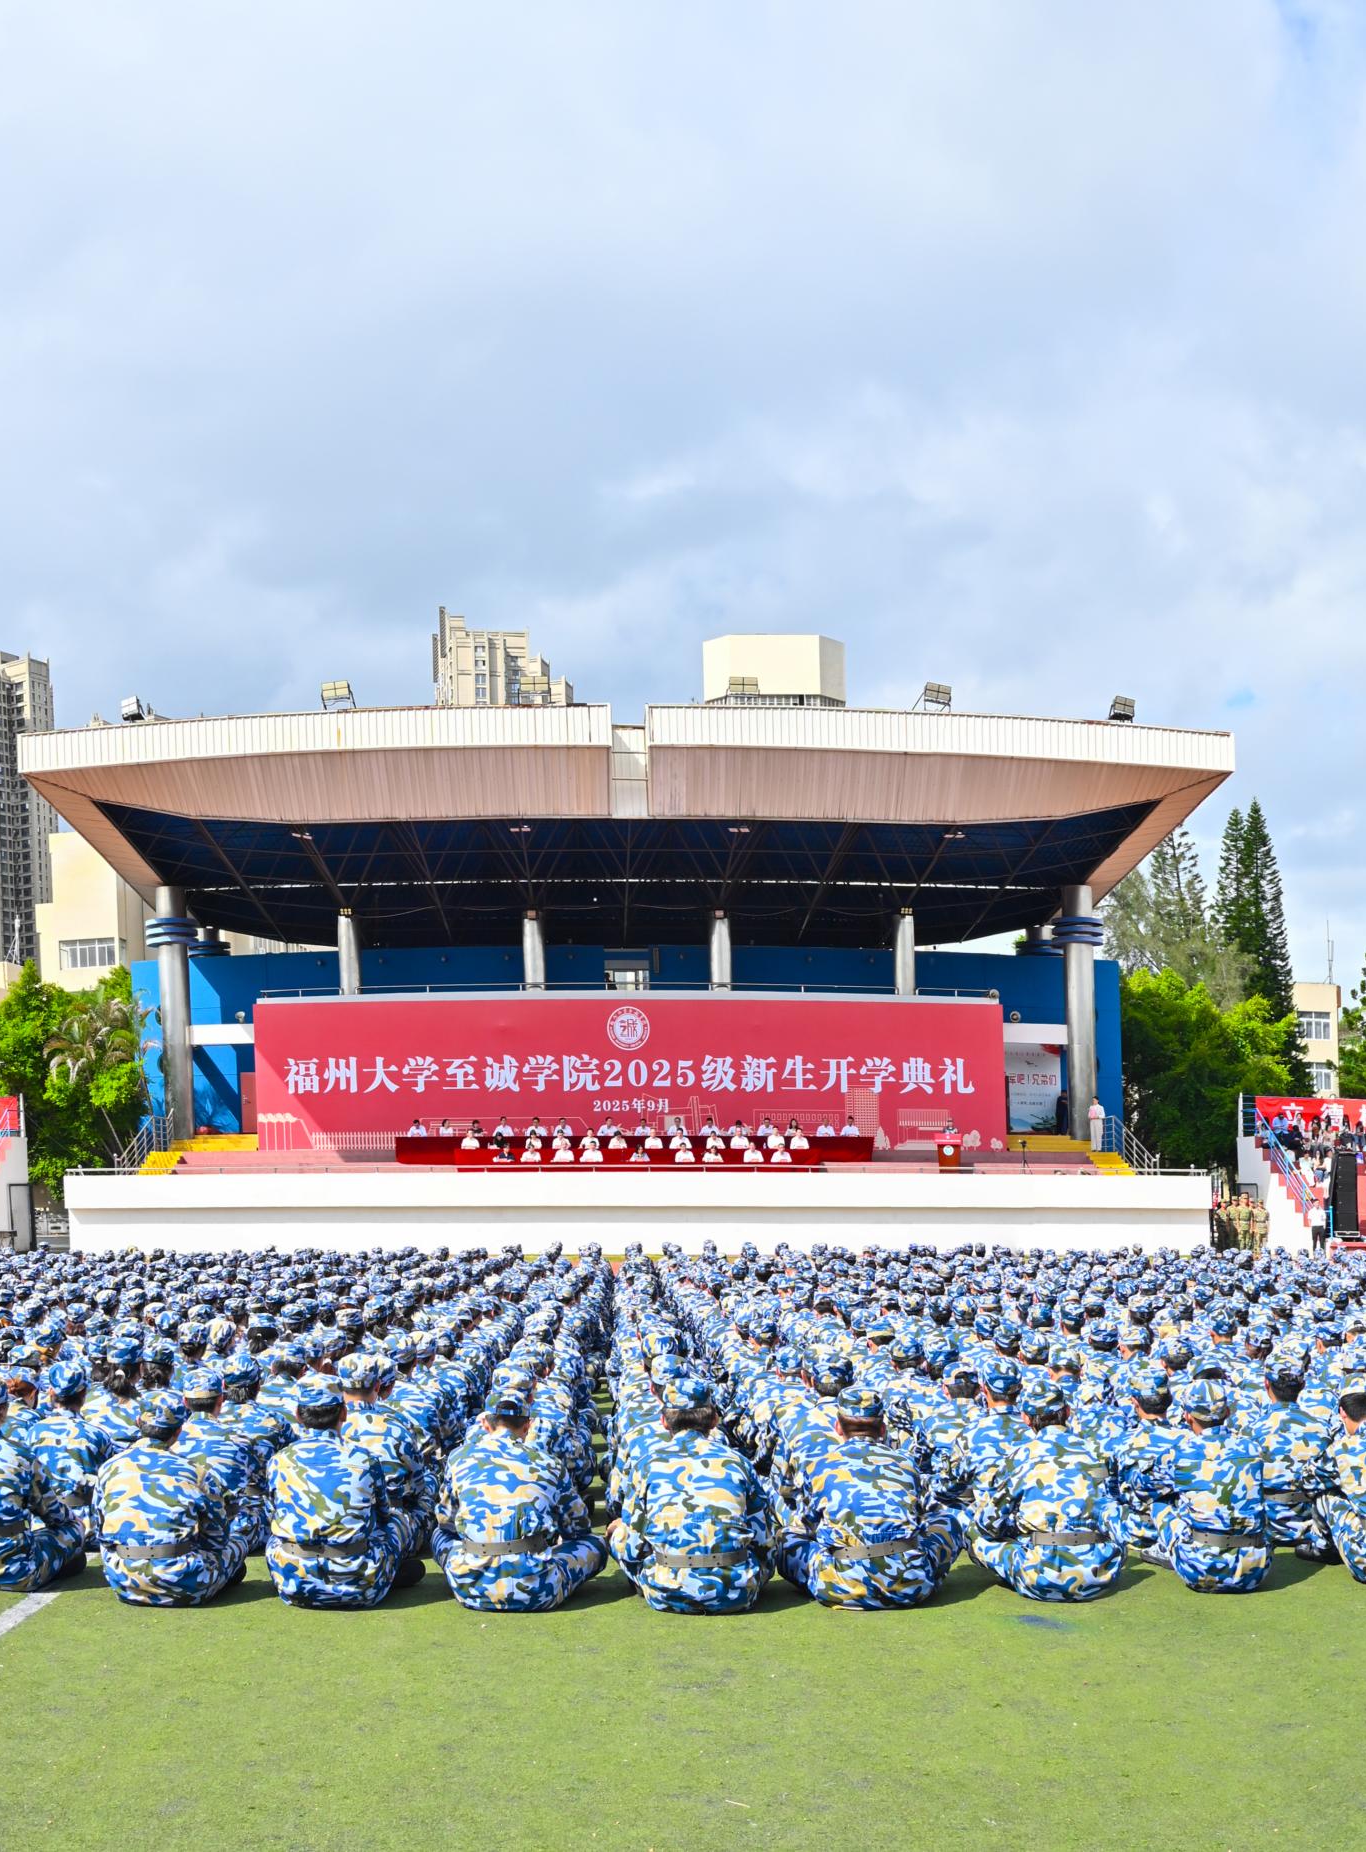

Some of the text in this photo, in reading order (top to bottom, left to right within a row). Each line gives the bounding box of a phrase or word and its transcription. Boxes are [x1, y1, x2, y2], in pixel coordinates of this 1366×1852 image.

[284, 1054, 976, 1095] 福州大学至诚学院2025级新生开学典礼
[593, 1098, 669, 1114] 2025年9月
